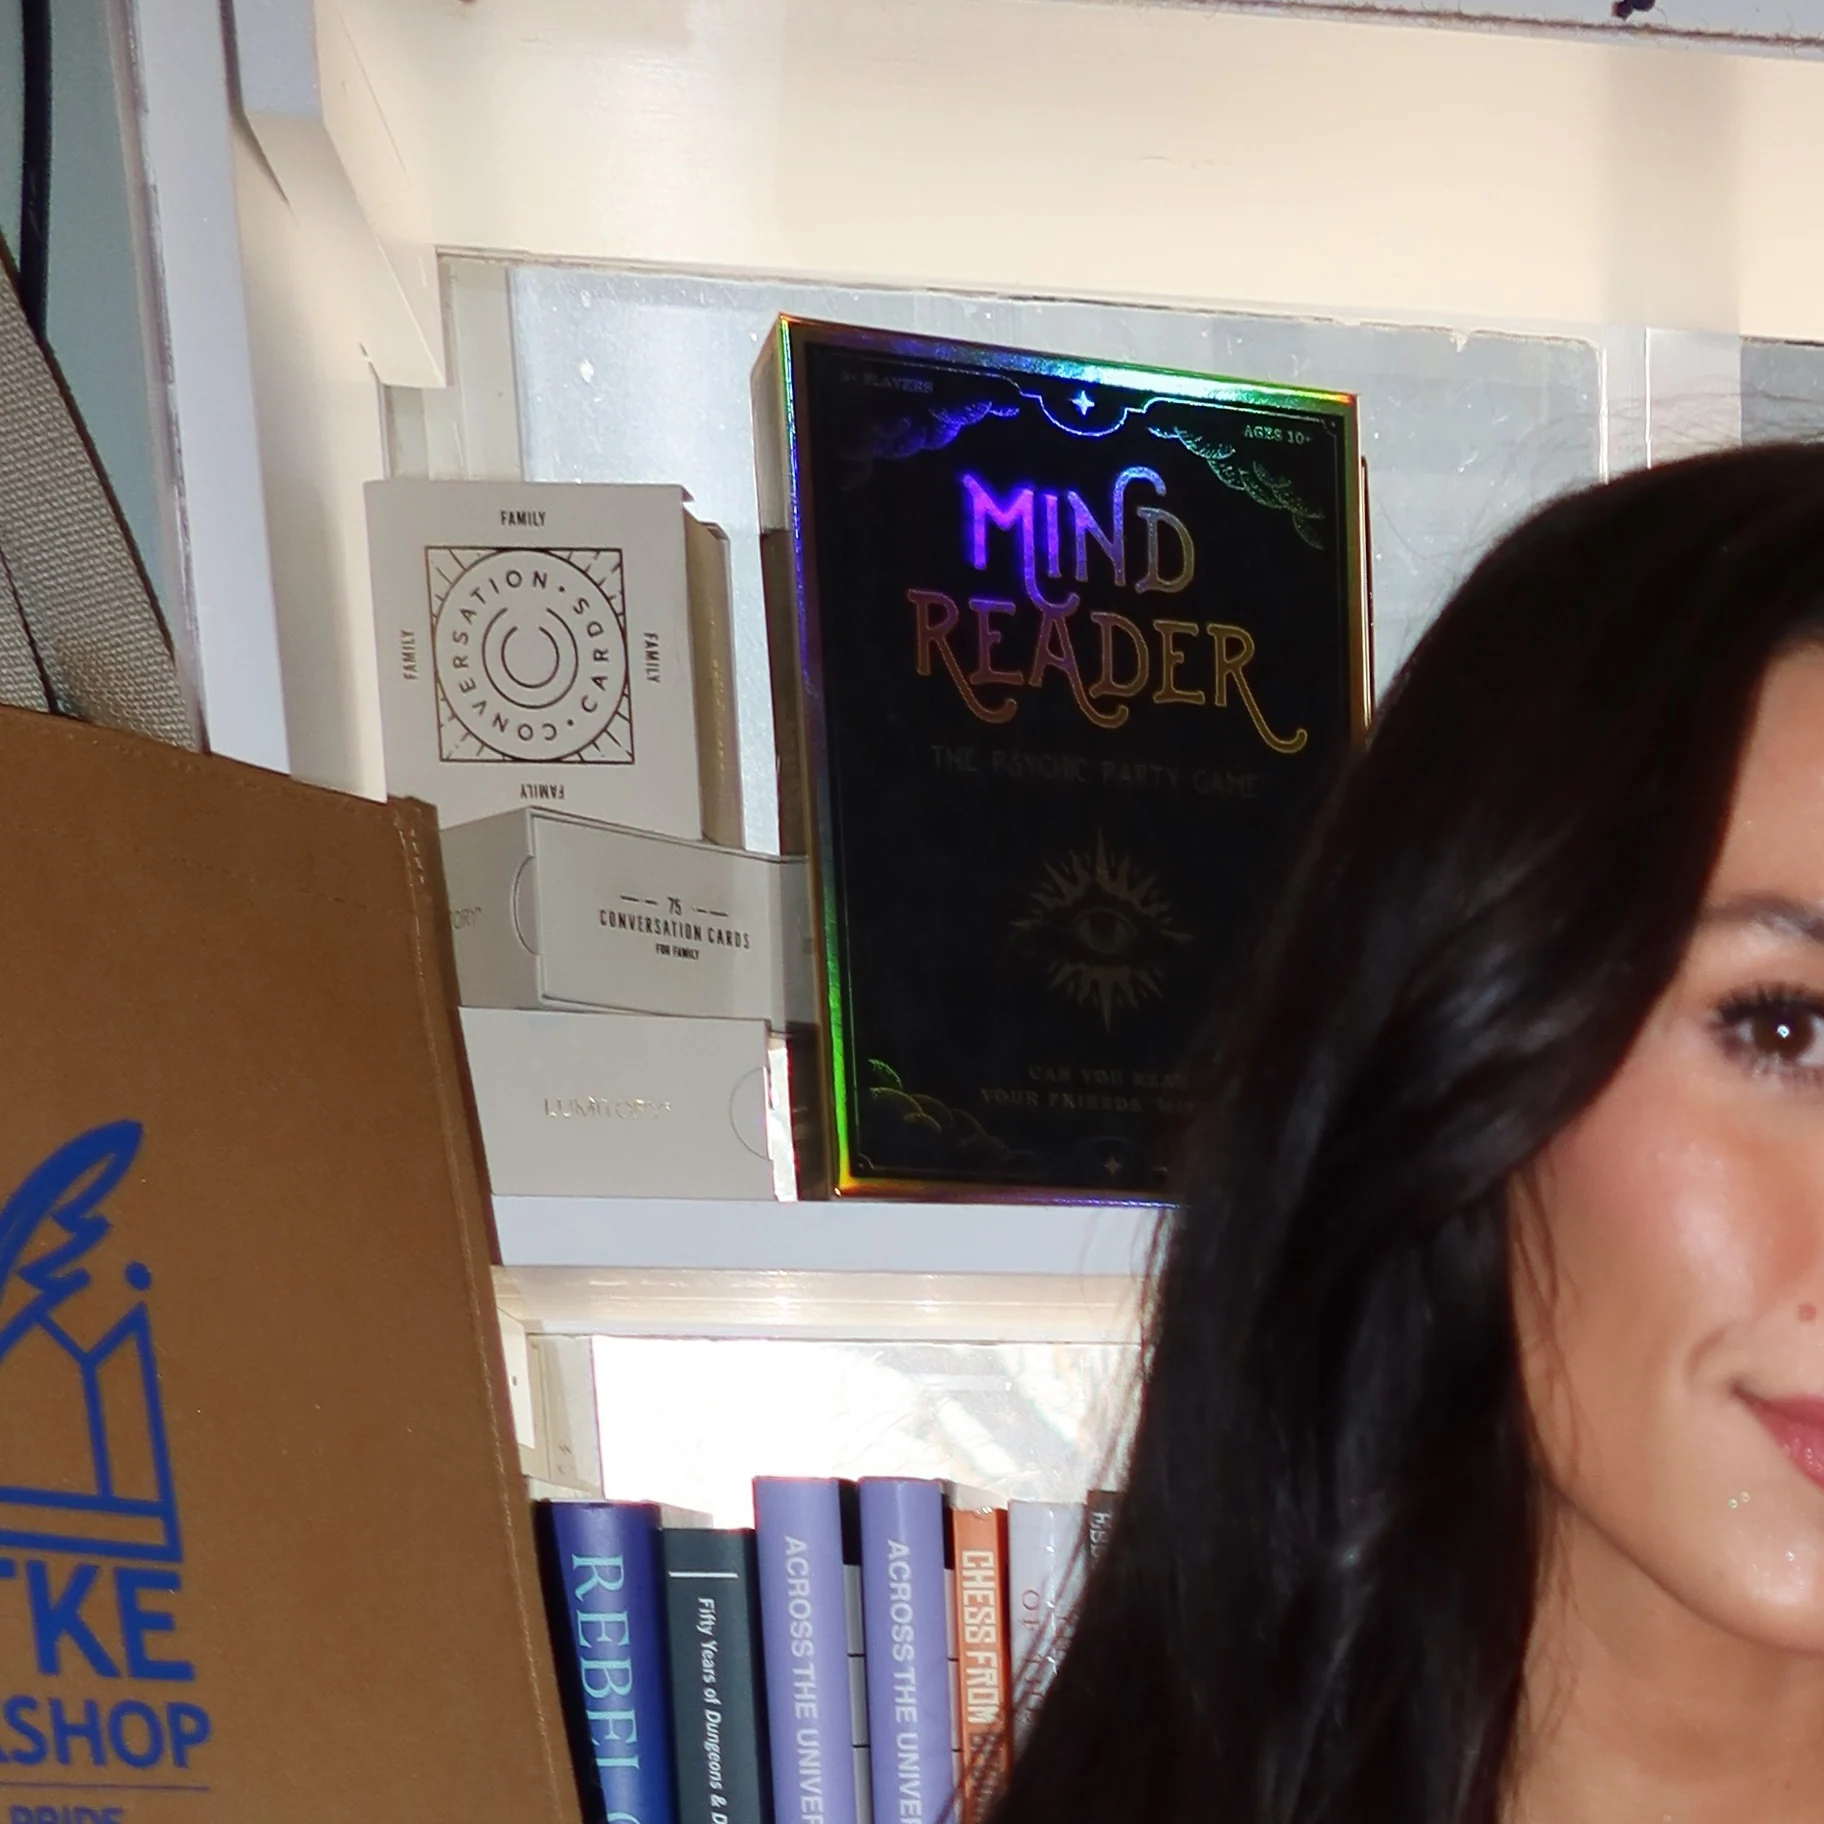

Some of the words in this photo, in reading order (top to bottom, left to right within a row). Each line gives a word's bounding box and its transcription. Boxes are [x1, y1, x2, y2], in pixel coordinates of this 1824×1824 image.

[1243, 422, 1282, 443] AGES
[501, 510, 546, 527] FAMILY
[960, 466, 1196, 612] MIND
[400, 629, 419, 680] FAMILY
[452, 569, 557, 741] CONVERSATION
[572, 597, 609, 713] CARDS
[643, 632, 661, 683] FAMILY
[905, 588, 1308, 755] READER
[520, 783, 564, 800] FAMILY
[931, 743, 978, 774] THE
[1194, 770, 1258, 799] GAME
[600, 909, 702, 943] CONVERSATION
[708, 926, 751, 951] CARDS
[666, 896, 683, 916] 75
[656, 943, 671, 956] FOR
[673, 944, 699, 960] FAMILY
[0, 1557, 196, 1682] KE
[696, 1597, 715, 1632] Fifty
[784, 1535, 813, 1659] ACROSS
[888, 1539, 915, 1662] ACROSS
[961, 1550, 995, 1644] CHESS
[700, 1637, 719, 1683] Years
[965, 1650, 1001, 1724] FROM
[704, 1688, 722, 1705] of
[792, 1664, 819, 1719] THE
[894, 1666, 918, 1723] THE
[0, 1694, 212, 1769] SHOP
[704, 1709, 722, 1790] Dungeons
[710, 1795, 728, 1808] &
